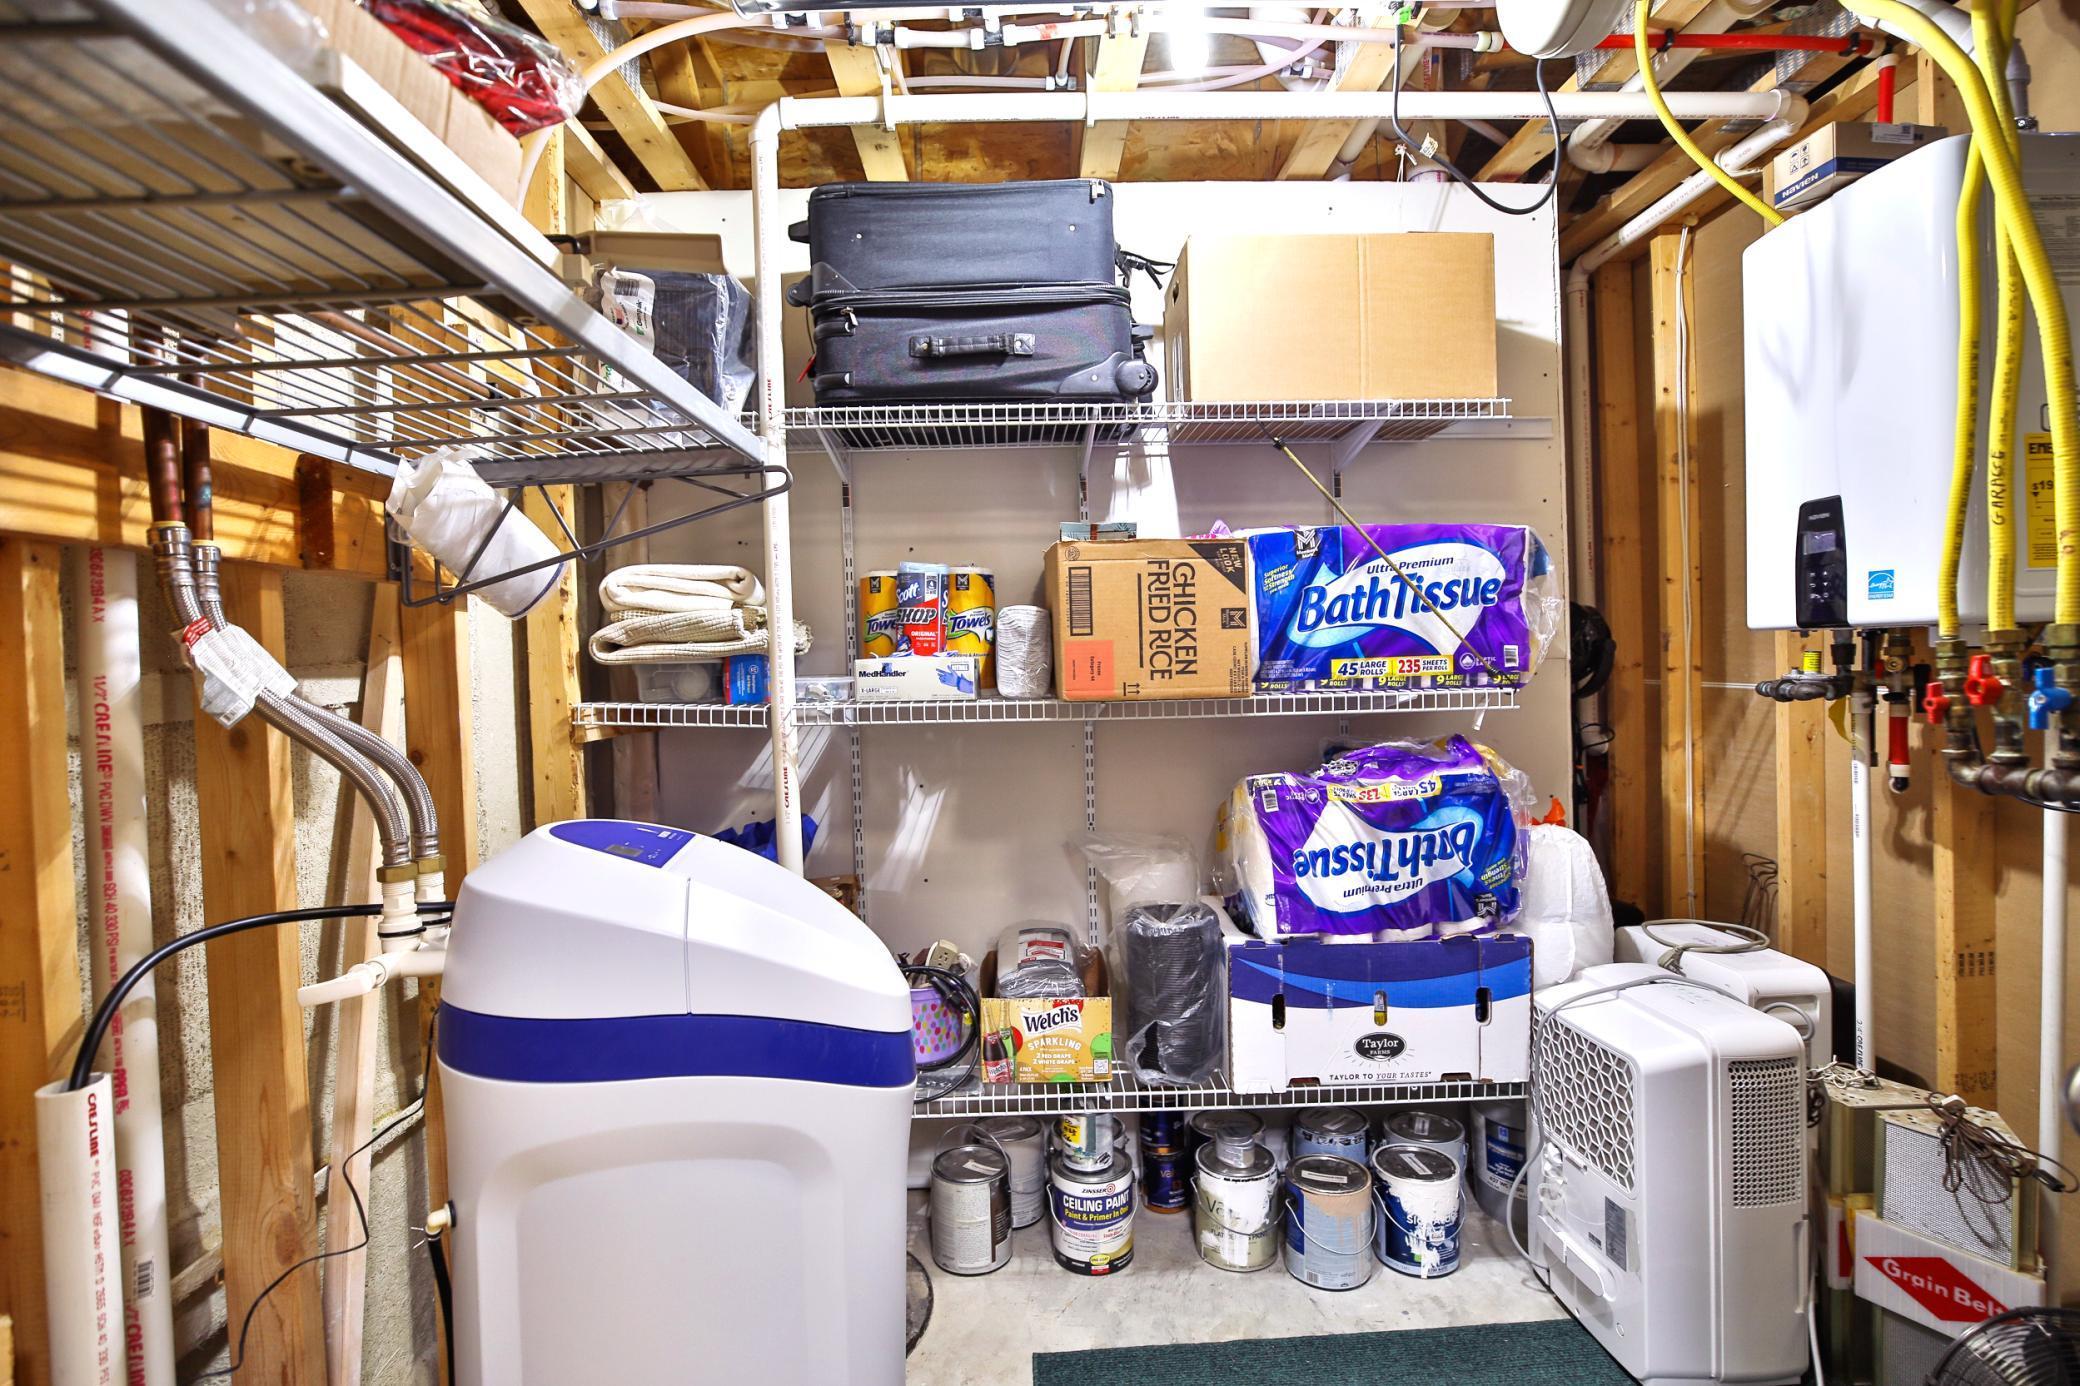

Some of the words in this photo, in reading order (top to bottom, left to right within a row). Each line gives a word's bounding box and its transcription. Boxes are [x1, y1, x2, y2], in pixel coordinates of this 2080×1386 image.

[2028, 442, 2054, 455] ENE
[1219, 547, 1235, 573] LOOK
[1229, 547, 1242, 568] NEW
[1399, 557, 1454, 570] Premium
[1147, 560, 1170, 624] FRIED
[896, 607, 938, 624] SHOP
[950, 613, 990, 633] Towels
[1172, 562, 1198, 675] CHICKEN
[1149, 629, 1173, 680] RICE
[859, 670, 907, 678] MedHandler
[1338, 660, 1358, 675] 45
[1360, 660, 1387, 669] LARGE
[1398, 659, 1421, 673] 235
[1422, 659, 1448, 667] SHEETS
[1378, 677, 1386, 686] 9
[1437, 675, 1444, 684] 9
[99, 782, 112, 801] PVC
[1419, 780, 1436, 794] 45
[100, 802, 112, 823] DWV
[1343, 883, 1392, 899] Premium
[1394, 878, 1423, 891] Ultra
[104, 902, 117, 914] 40
[105, 915, 117, 932] 330
[1023, 1007, 1079, 1032] Welch's
[1028, 1037, 1081, 1051] SPARKLING
[1362, 1038, 1399, 1049] Taylor
[1329, 1073, 1360, 1081] TAYLOR
[1375, 1072, 1397, 1080] YOUR
[88, 1092, 100, 1157] CRESLINE
[1063, 1195, 1102, 1212] CEILING
[1106, 1189, 1129, 1210] PAINT
[1064, 1209, 1081, 1220] Paint
[1089, 1213, 1112, 1221] Primer
[1881, 1258, 1949, 1298] Grain
